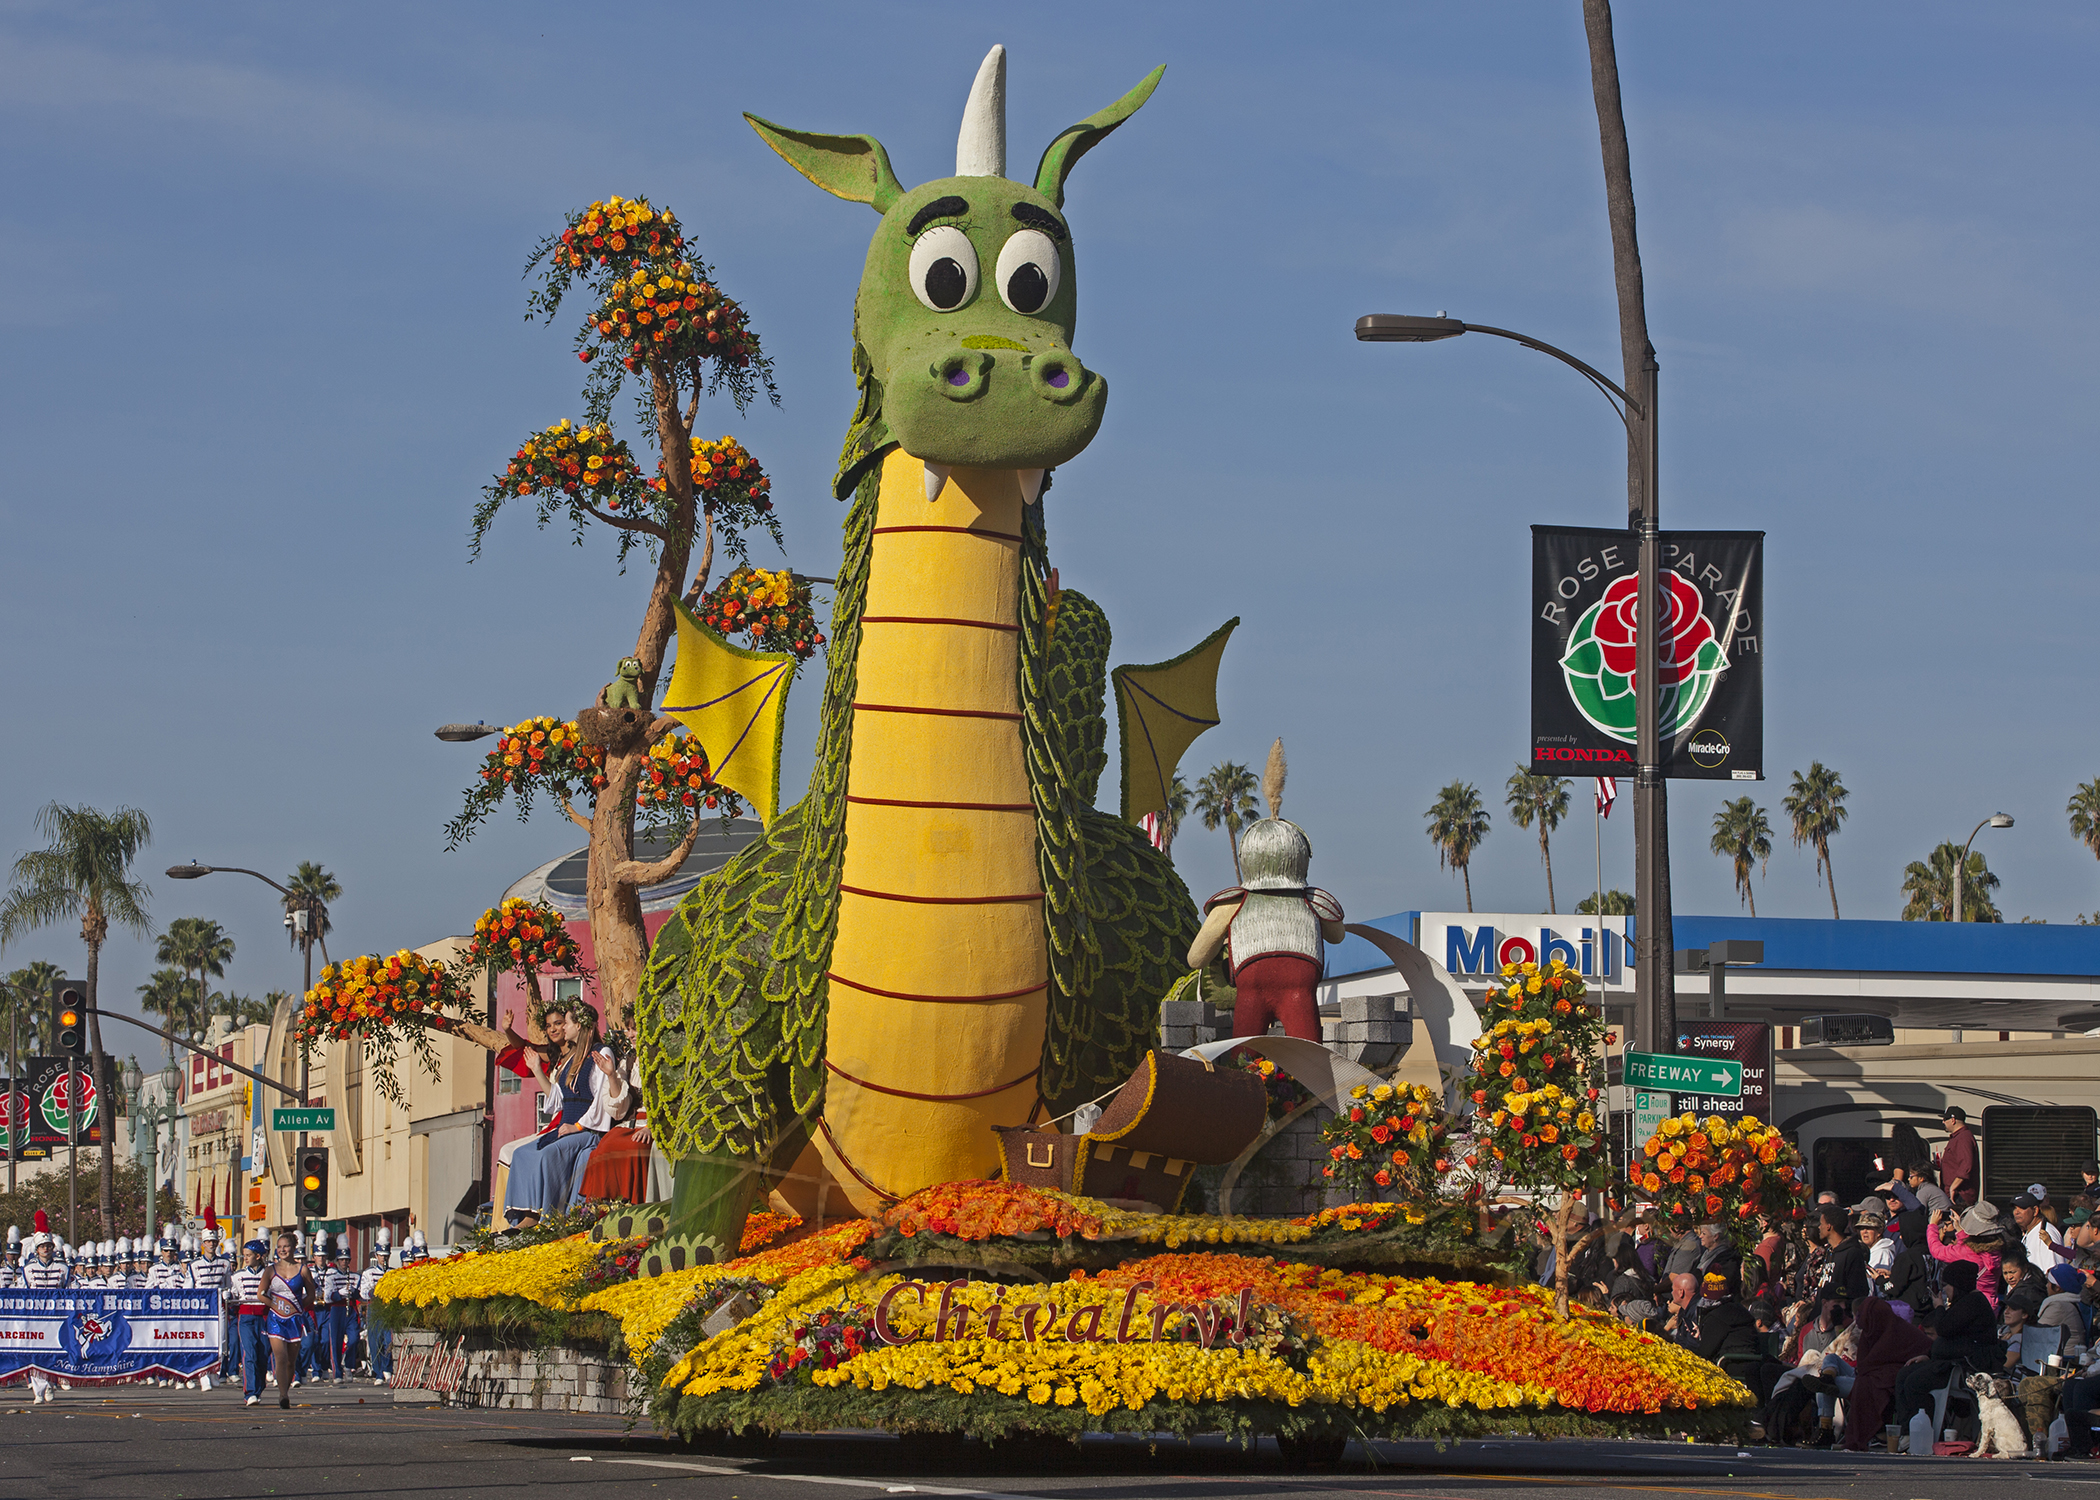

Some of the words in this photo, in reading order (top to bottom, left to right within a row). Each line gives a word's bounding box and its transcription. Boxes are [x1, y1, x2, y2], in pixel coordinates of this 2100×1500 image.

[1540, 545, 1624, 626] ROSE
[1660, 544, 1759, 656] PARADE
[1536, 734, 1568, 744] presented
[1568, 736, 1578, 744] by
[1534, 747, 1635, 763] HONDA
[1446, 925, 1612, 977] Mobil
[1693, 1036, 1735, 1050] Synergy
[32, 1062, 64, 1093] ROSE
[1630, 1062, 1703, 1083] FREEWAY
[1742, 1085, 1763, 1095] are
[1638, 1096, 1647, 1108] 2
[1650, 1099, 1668, 1108] HOUR
[1702, 1097, 1744, 1111] ahead
[279, 1115, 309, 1125] Allen
[315, 1114, 330, 1125] Av
[150, 1294, 209, 1311] SCHOOL
[874, 1279, 1252, 1350] Chivalry!
[154, 1328, 205, 1340] LANCERS
[54, 1359, 80, 1372] New
[81, 1360, 135, 1375] Hampshire
